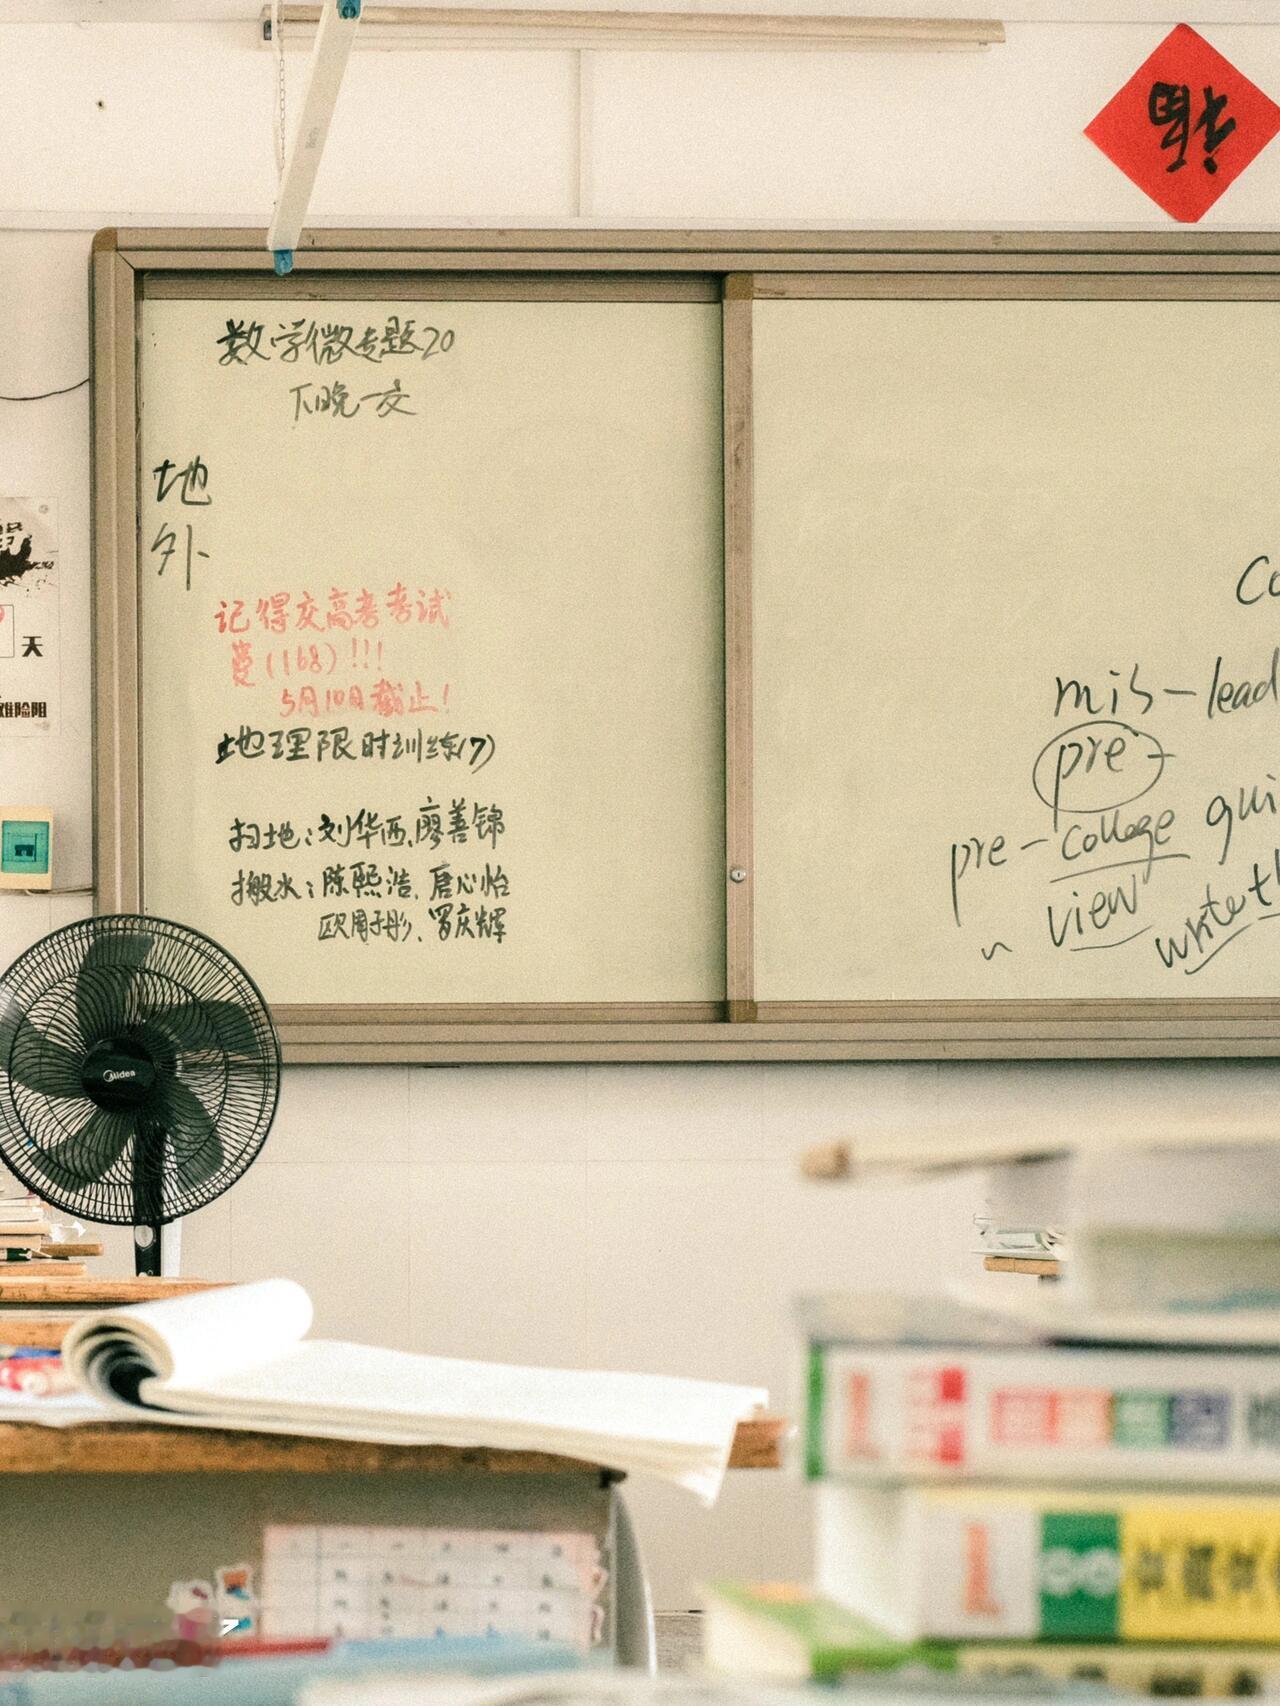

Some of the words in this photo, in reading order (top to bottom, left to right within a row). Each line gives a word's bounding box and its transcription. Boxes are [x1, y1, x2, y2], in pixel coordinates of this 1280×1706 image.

[217, 315, 455, 366] 数学微专题20
[214, 582, 452, 633] 记得交高考考试
[21, 636, 44, 658] 天
[1047, 873, 1137, 947] view
[103, 1069, 136, 1083] Midea
